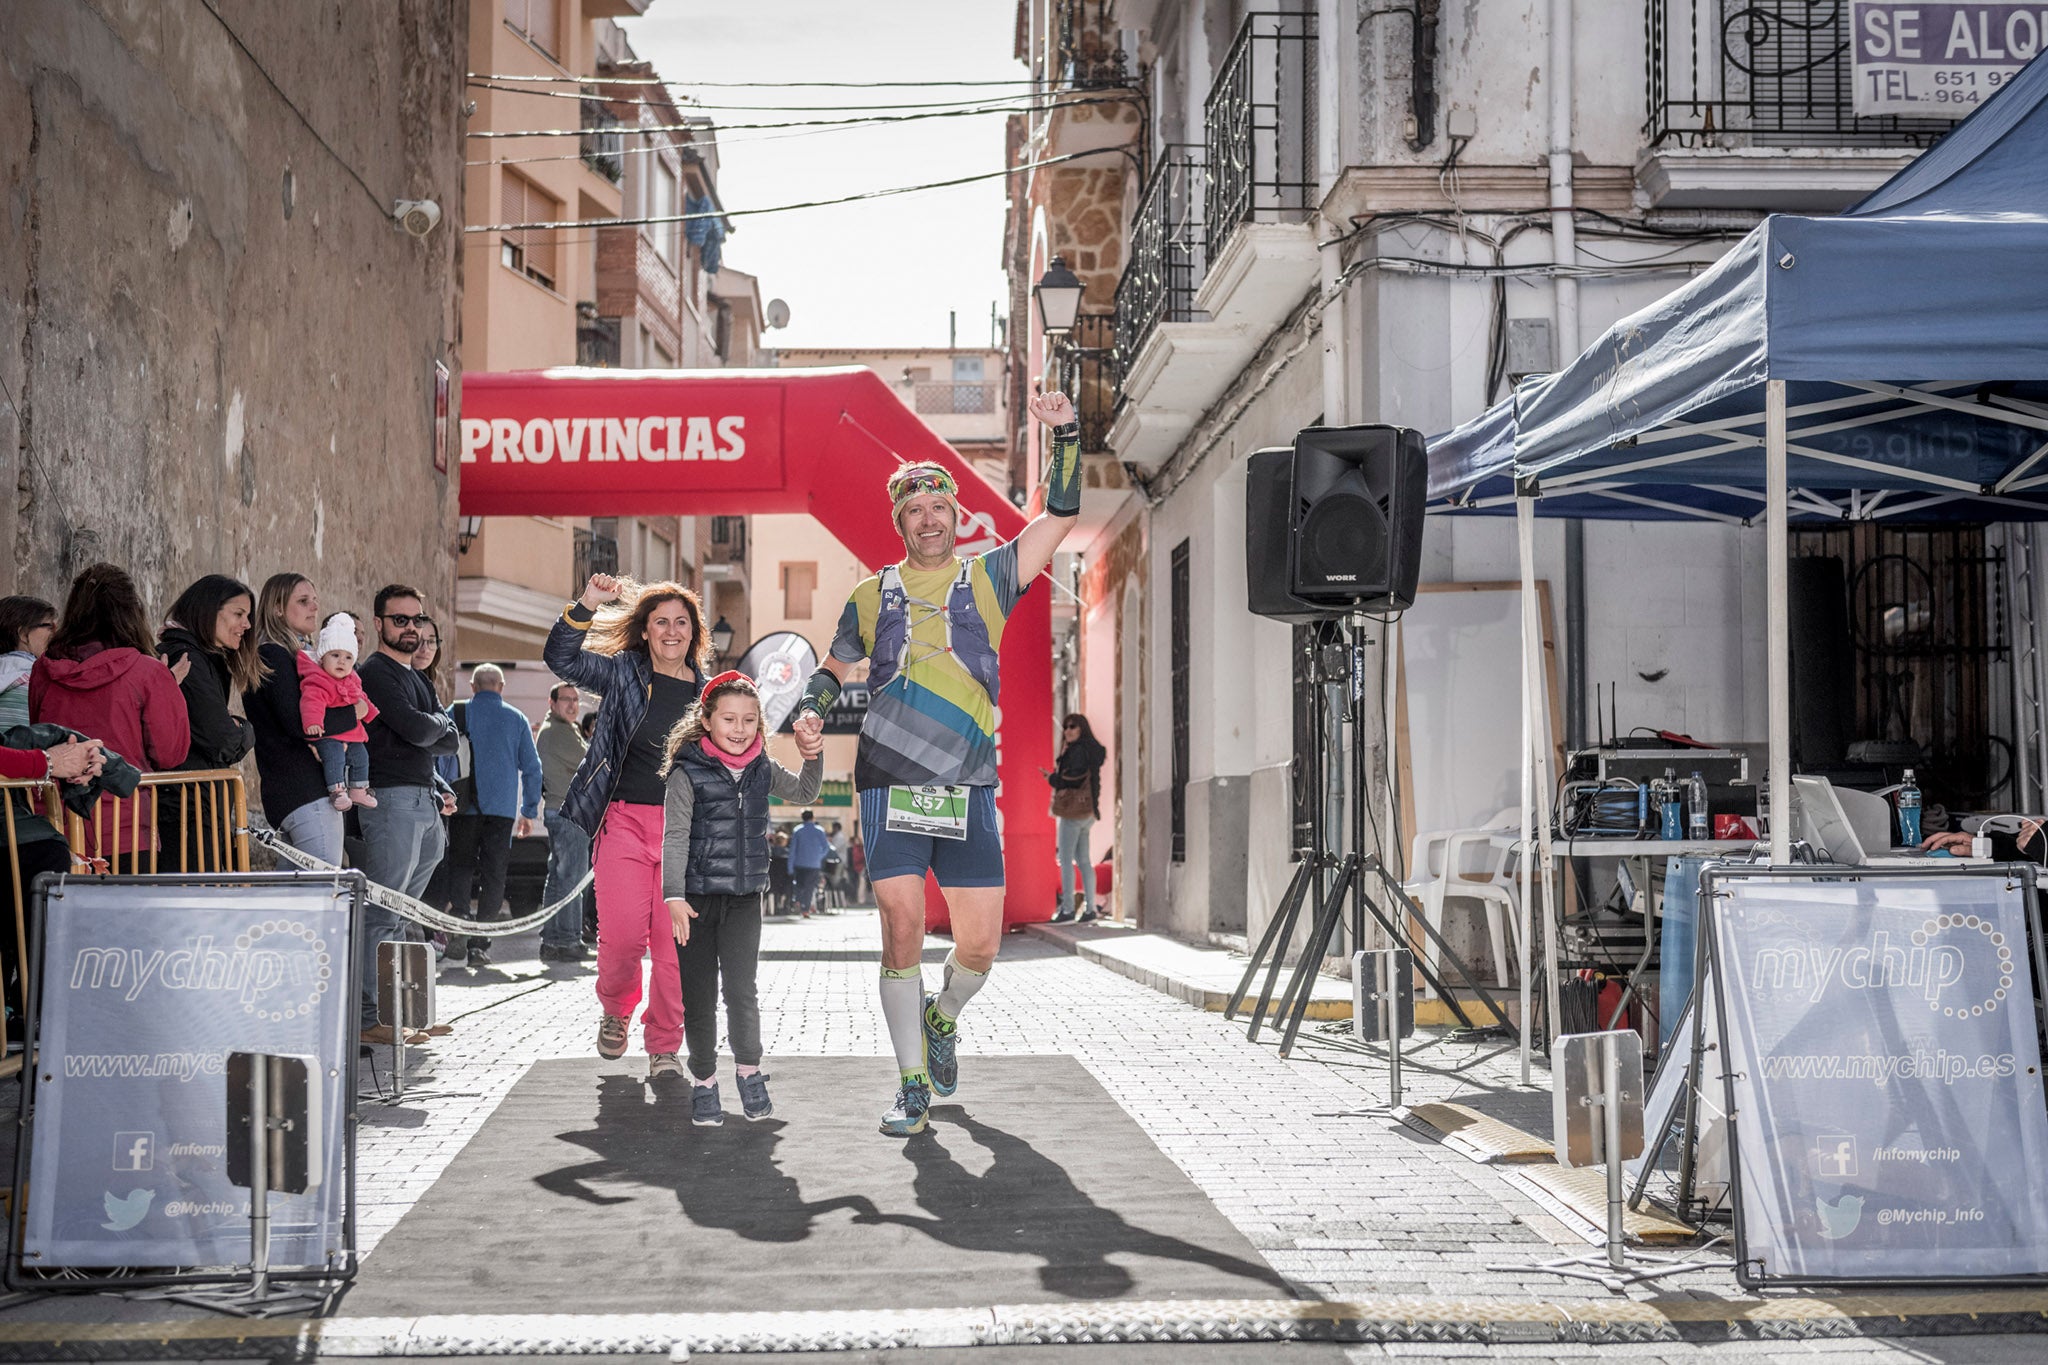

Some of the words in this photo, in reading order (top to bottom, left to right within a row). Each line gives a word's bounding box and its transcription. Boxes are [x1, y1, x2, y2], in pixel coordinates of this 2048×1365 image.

[1864, 9, 1921, 58] SE
[1934, 71, 1976, 86] 651
[1935, 89, 1980, 104] 964
[460, 416, 746, 463] PROVINCIAS
[911, 794, 945, 811] 857
[70, 936, 284, 1004] mychip
[1752, 931, 1964, 1003] mychip
[64, 1052, 230, 1083] www.myc
[1757, 1049, 2016, 1085] www.mychip.es
[168, 1142, 228, 1157] /infomy
[1873, 1147, 1961, 1163] /infomychip
[164, 1201, 271, 1217] @Mychip_I
[1877, 1208, 1984, 1225] @Mychip_Info
